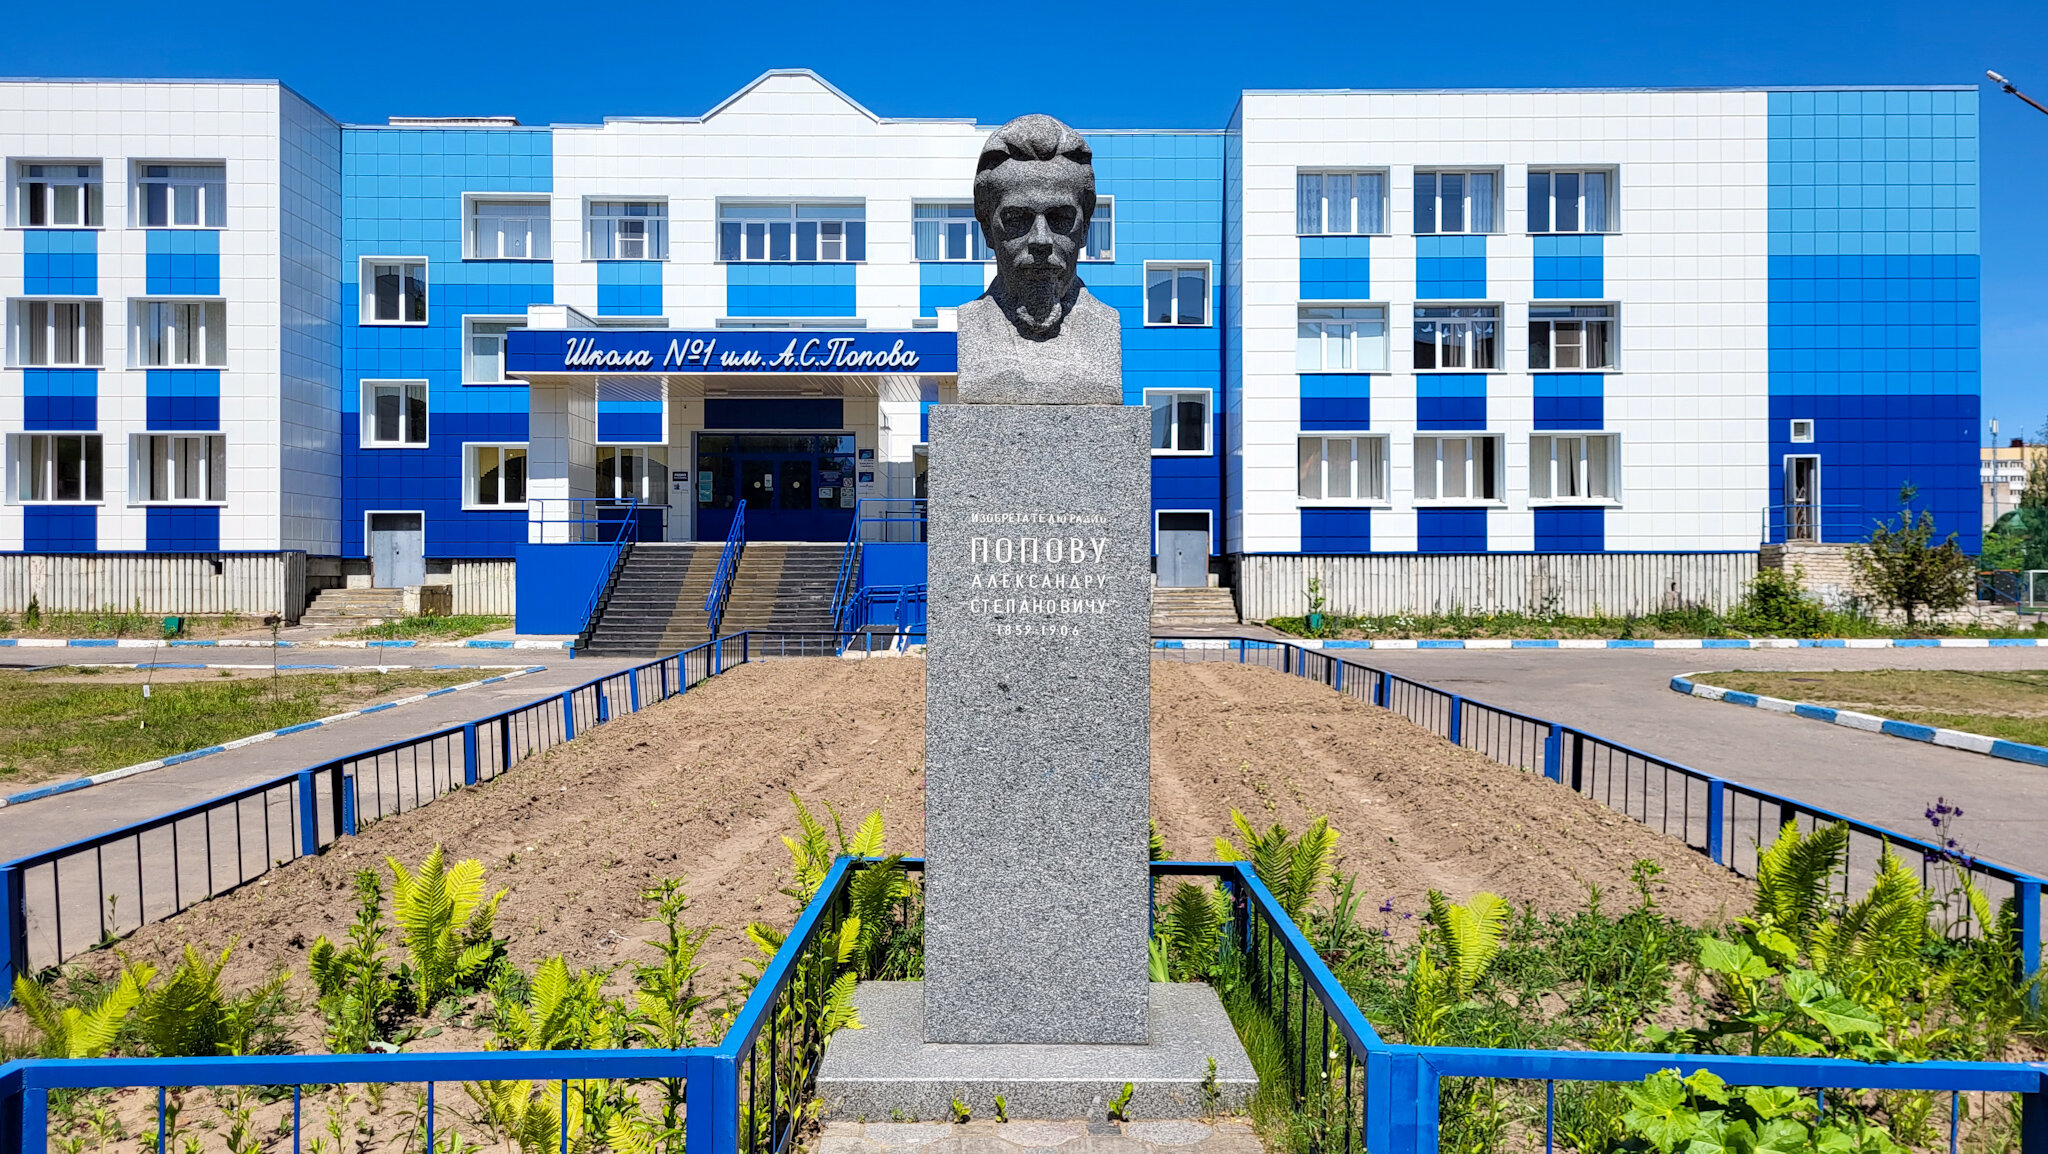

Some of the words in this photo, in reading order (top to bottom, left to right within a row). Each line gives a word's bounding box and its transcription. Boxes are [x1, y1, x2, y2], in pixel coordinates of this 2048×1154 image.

[564, 337, 654, 367] Школа
[663, 338, 717, 367] №1
[720, 350, 767, 367] им.
[971, 513, 1067, 523] ИЗОБРЕТАТЕЛЮ
[971, 536, 1107, 564] ПОПОВУ
[971, 573, 1106, 589] АЛЕКСАНДРУ
[970, 598, 1107, 614] СТЕПАНОВИЧУ
